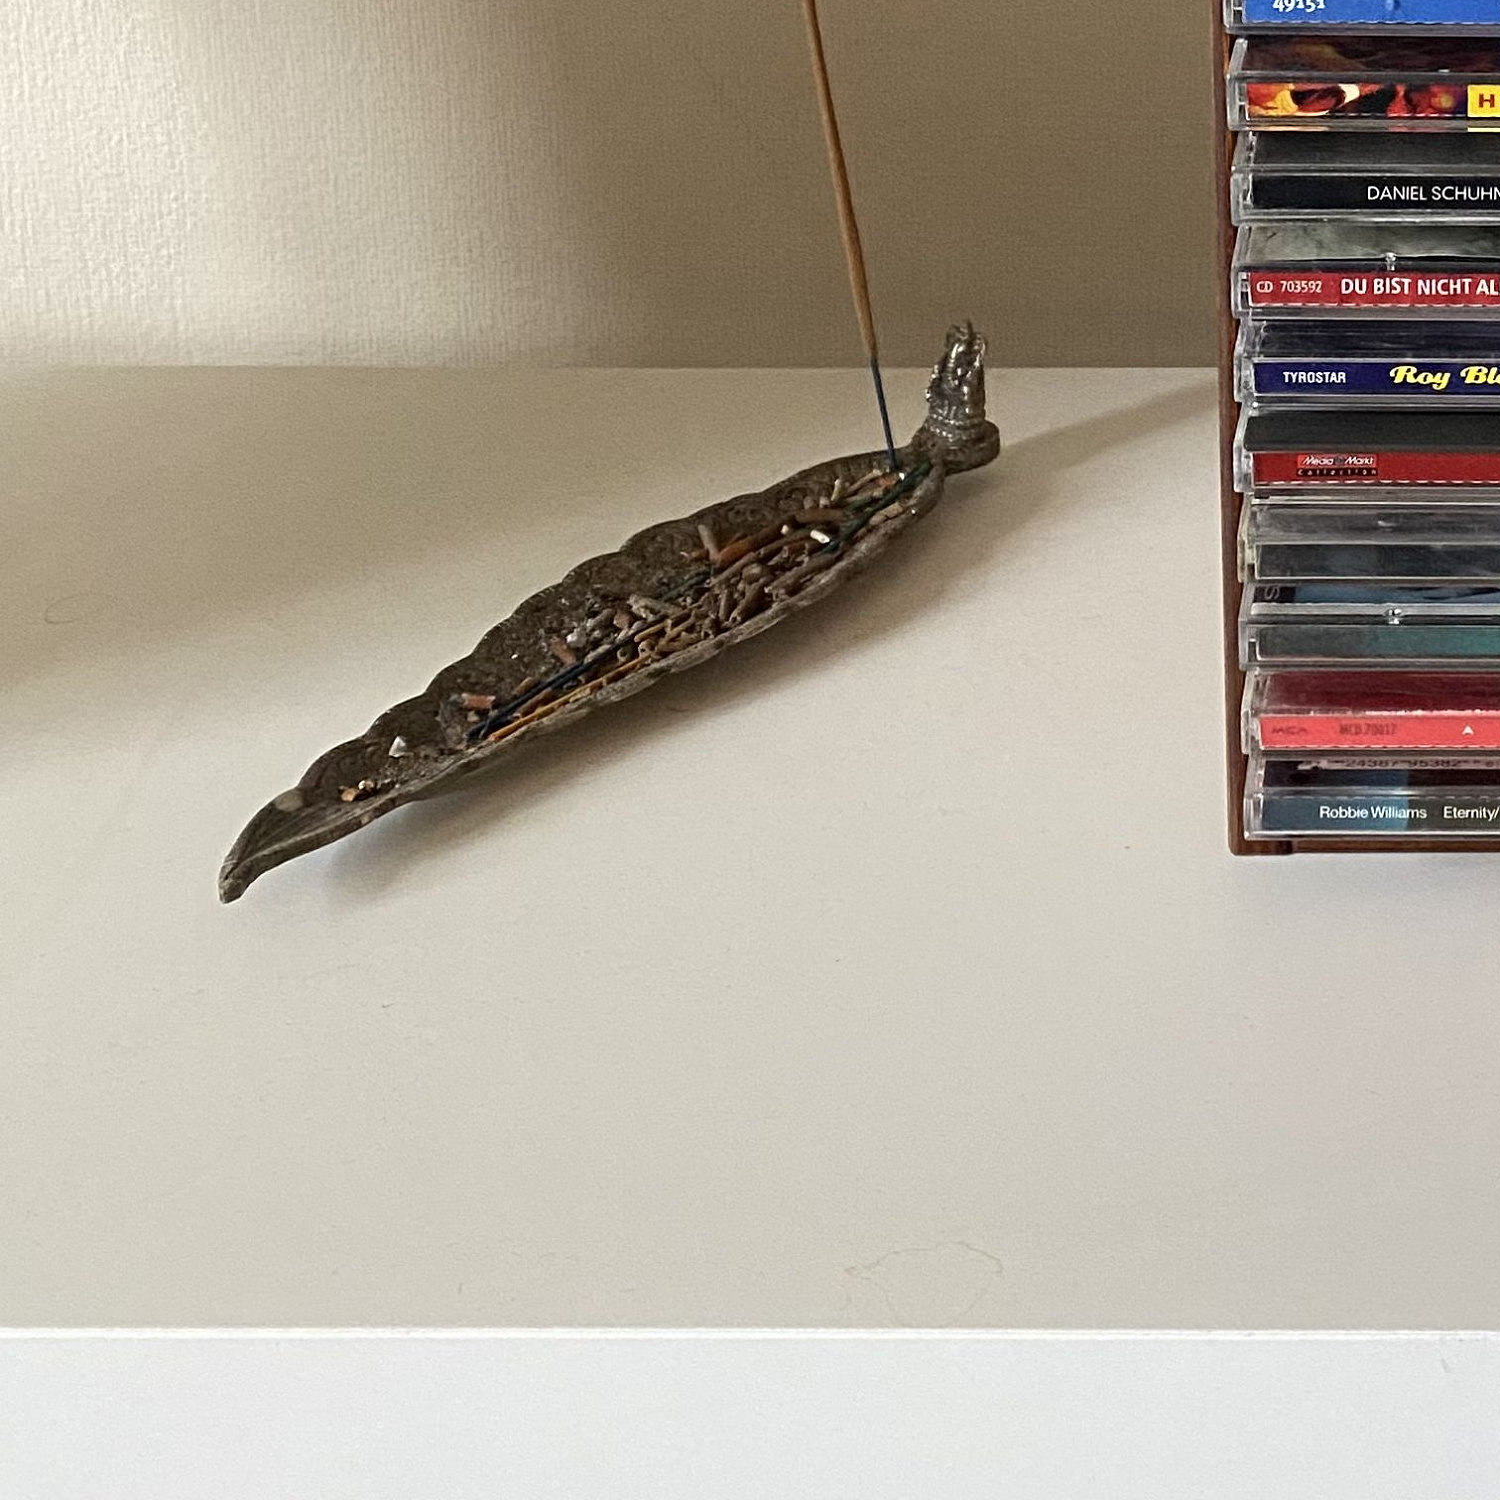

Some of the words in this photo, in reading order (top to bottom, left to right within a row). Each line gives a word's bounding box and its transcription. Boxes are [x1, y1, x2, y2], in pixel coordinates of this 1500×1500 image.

[1367, 186, 1427, 201] DANIEL
[1257, 281, 1273, 292] CD
[1280, 281, 1322, 293] 703592
[1341, 279, 1367, 294] DU
[1373, 279, 1411, 295] BIST
[1418, 279, 1470, 295] NICHT
[1283, 371, 1346, 383] TYROSTAR
[1390, 366, 1451, 390] Roy
[1319, 806, 1368, 819] Robbie
[1371, 806, 1427, 819] Williams
